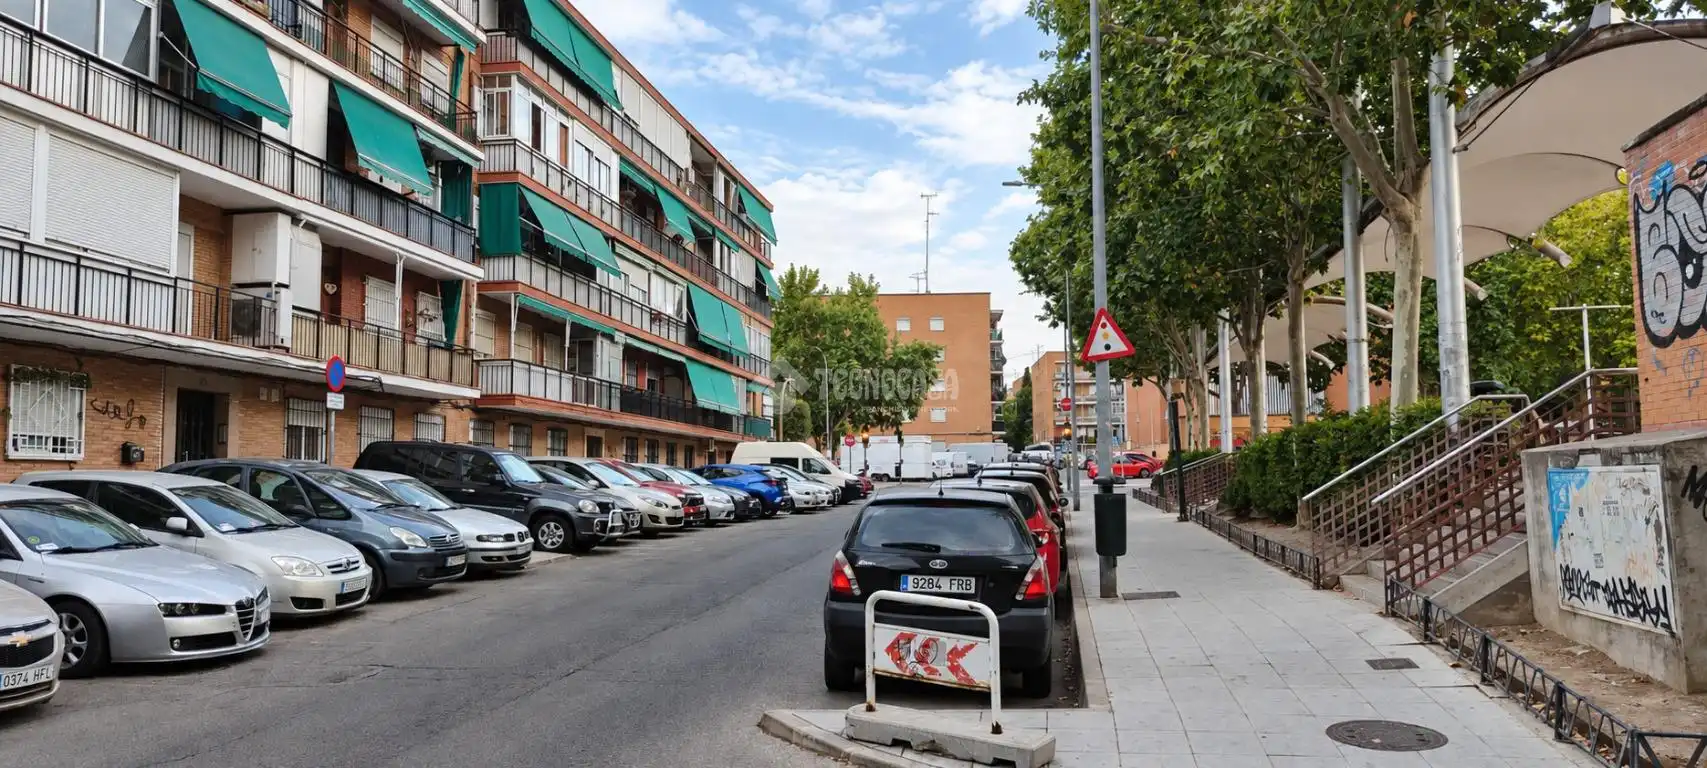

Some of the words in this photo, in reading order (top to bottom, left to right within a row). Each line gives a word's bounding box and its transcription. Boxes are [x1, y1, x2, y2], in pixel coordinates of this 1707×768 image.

[912, 577, 942, 591] 9284
[949, 579, 972, 592] FRB
[3, 671, 29, 688] 0374
